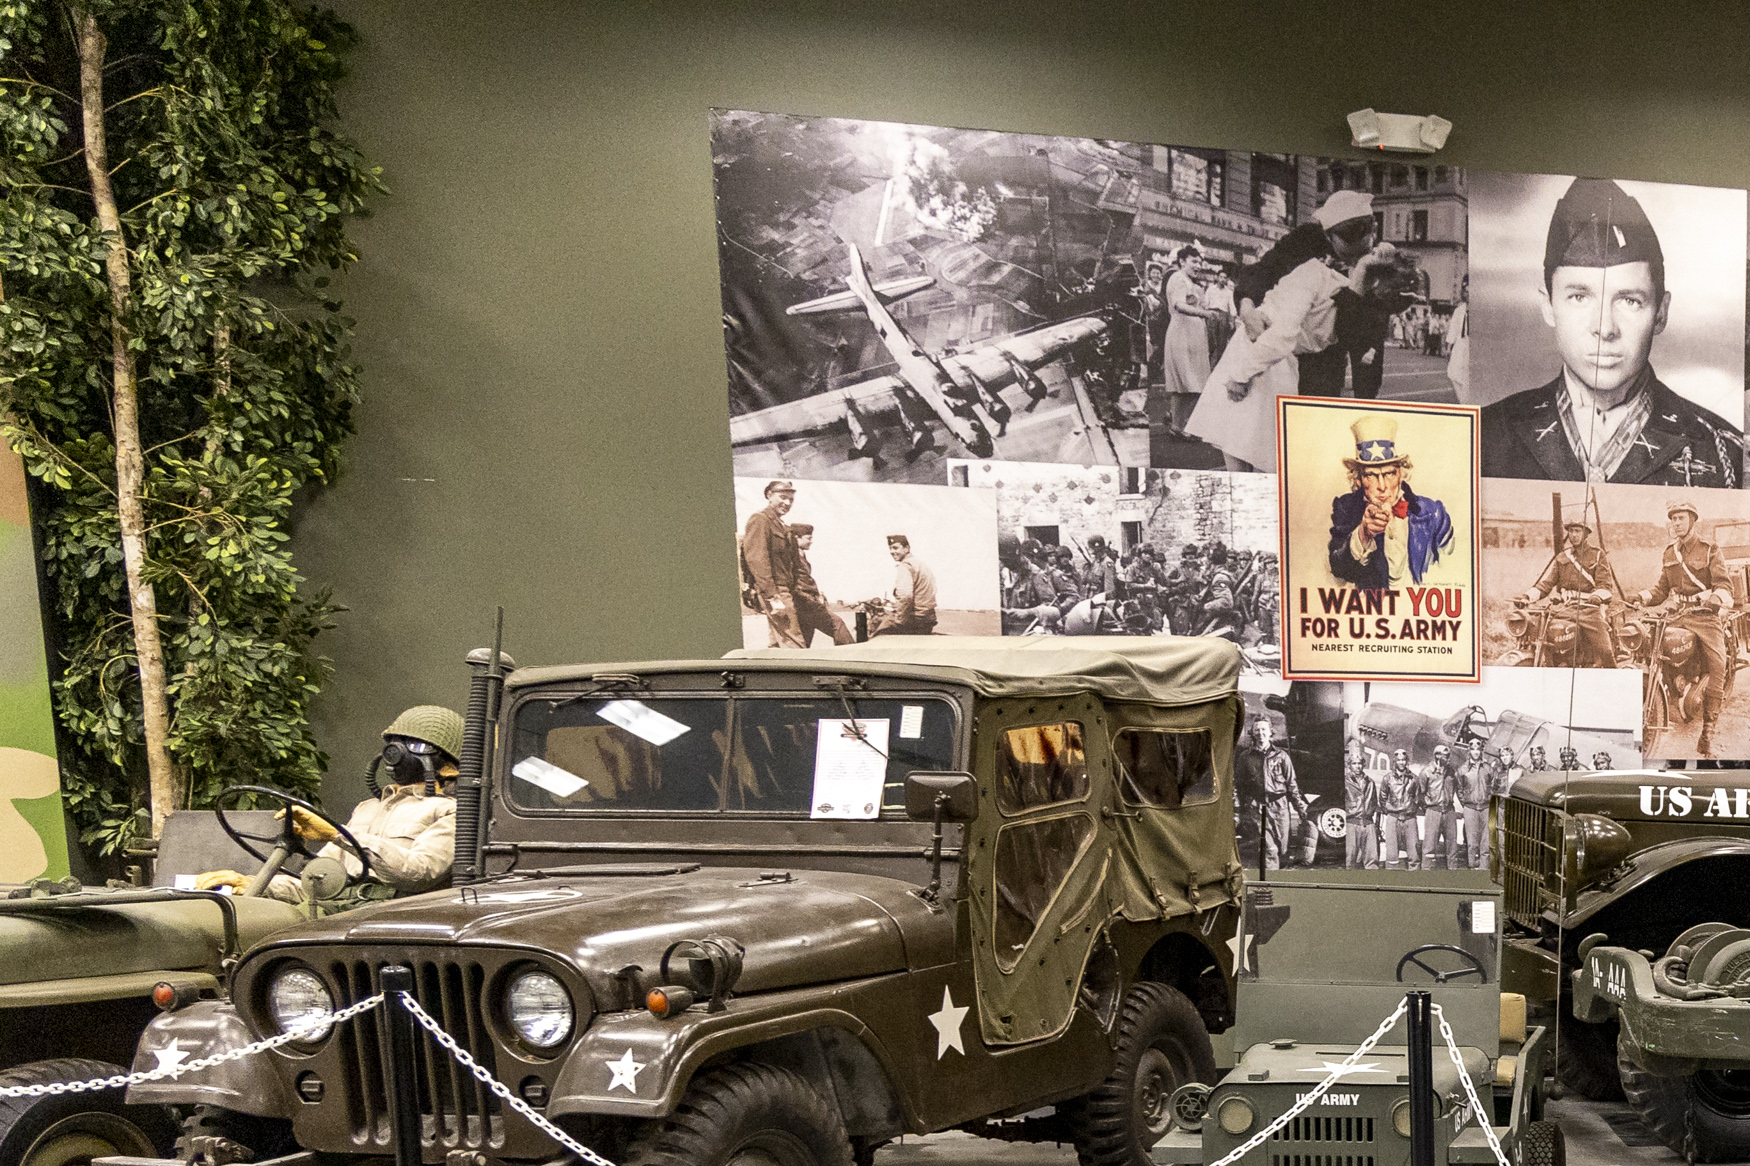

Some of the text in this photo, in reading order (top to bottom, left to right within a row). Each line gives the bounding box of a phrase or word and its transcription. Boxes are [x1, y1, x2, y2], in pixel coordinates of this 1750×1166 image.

[1300, 587, 1462, 618] I WANT YOU
[1300, 617, 1340, 639] FOR
[1311, 643, 1453, 655] NEAREST RECRUITING STATION
[1638, 785, 1693, 817] US
[1320, 1093, 1360, 1106] ARMY
